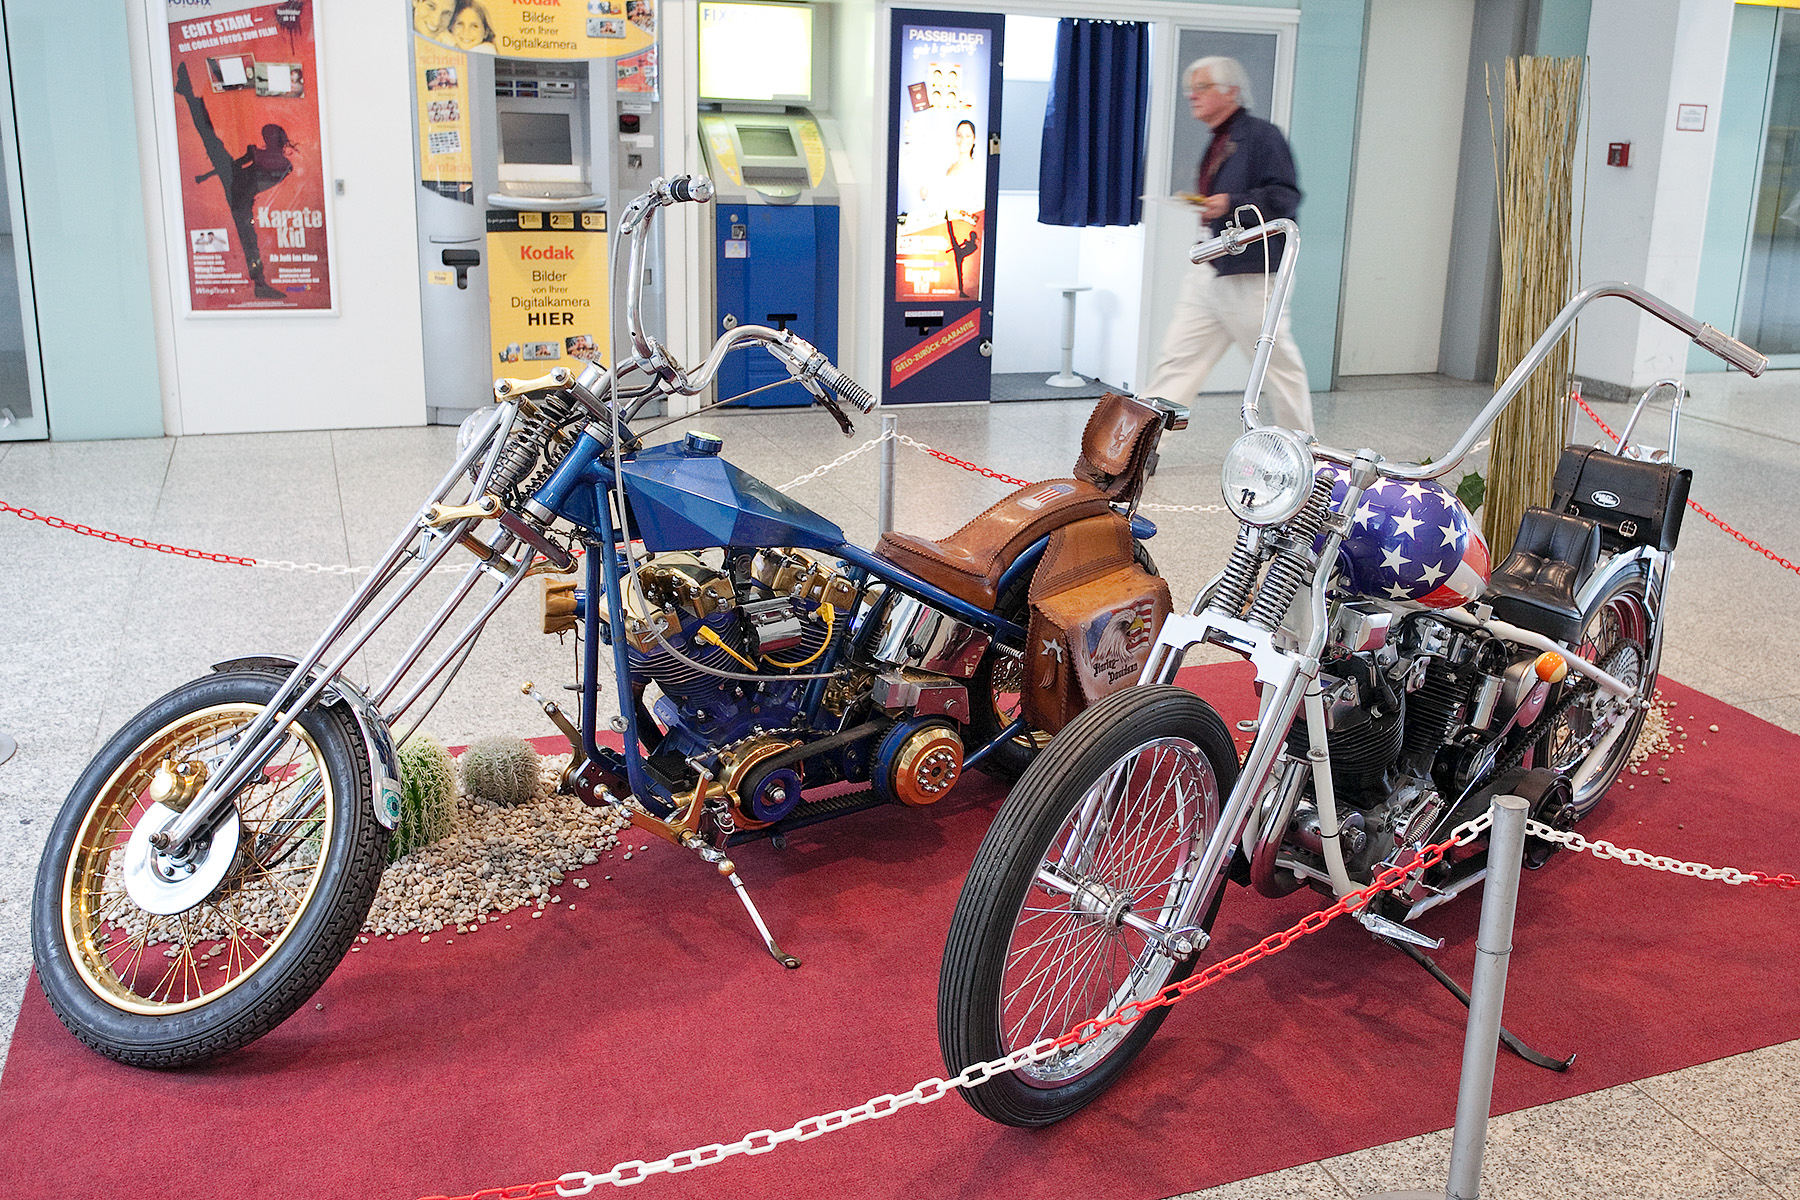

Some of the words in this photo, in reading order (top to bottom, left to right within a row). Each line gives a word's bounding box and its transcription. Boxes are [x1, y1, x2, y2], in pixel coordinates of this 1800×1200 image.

[522, 11, 555, 23] Bilder
[181, 21, 213, 39] ECHT
[214, 14, 254, 33] STARK
[519, 27, 535, 35] von
[538, 26, 559, 35] Ihrer
[178, 44, 191, 53] DIE
[191, 38, 219, 50] COOLEN
[219, 33, 242, 45] FOTOS
[502, 36, 577, 51] Digitalkamera
[909, 29, 984, 45] PASSBILDER
[257, 207, 323, 229] Karate
[520, 215, 526, 225] 1
[552, 215, 559, 225] 2
[584, 216, 591, 225] 3
[277, 227, 306, 248] Kid
[520, 245, 575, 260] Kodak
[532, 270, 567, 282] Bilder
[549, 285, 568, 294] Ihrer
[511, 296, 590, 311] Digitalkamera
[528, 312, 574, 326] HIER
[895, 319, 975, 373] GELD-ZURÜCK-GARANTIE
[1108, 662, 1138, 685] Davidson
